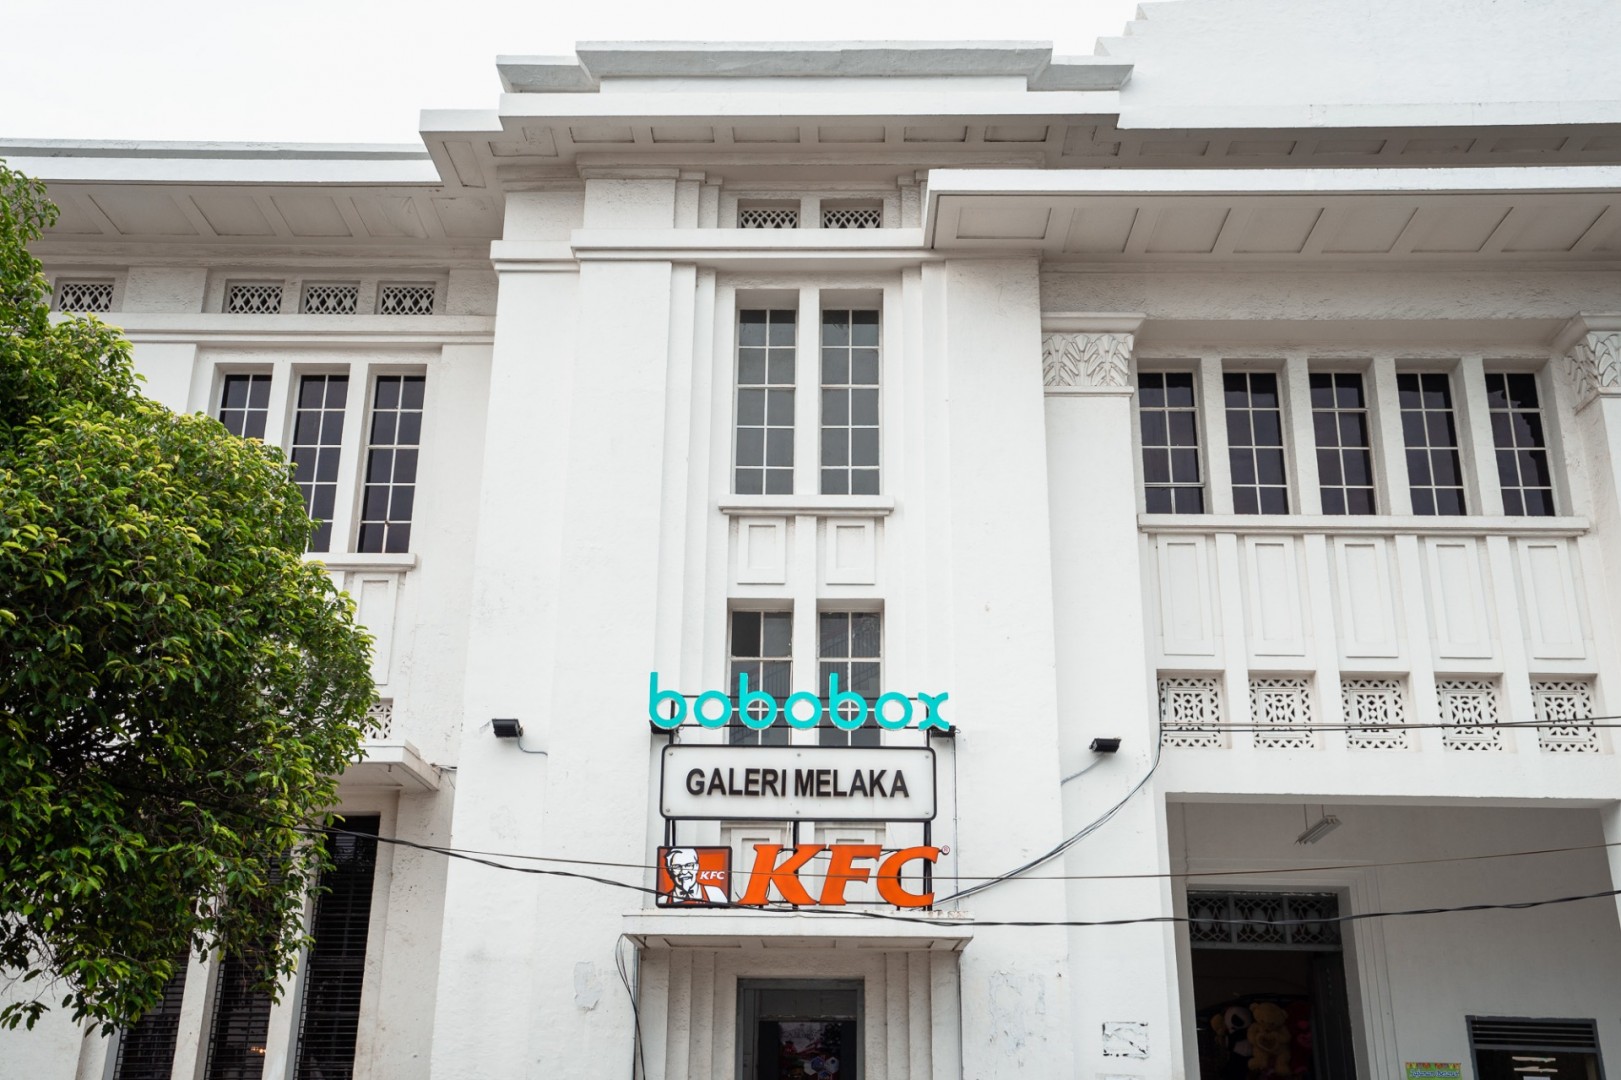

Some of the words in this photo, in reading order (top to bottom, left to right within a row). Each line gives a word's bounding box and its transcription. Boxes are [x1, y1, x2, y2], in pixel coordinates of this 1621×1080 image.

[649, 672, 950, 731] bobobox
[686, 768, 787, 797] GALERI
[794, 769, 910, 798] MELAKA
[700, 871, 725, 880] KFC
[738, 844, 941, 908] KFC
